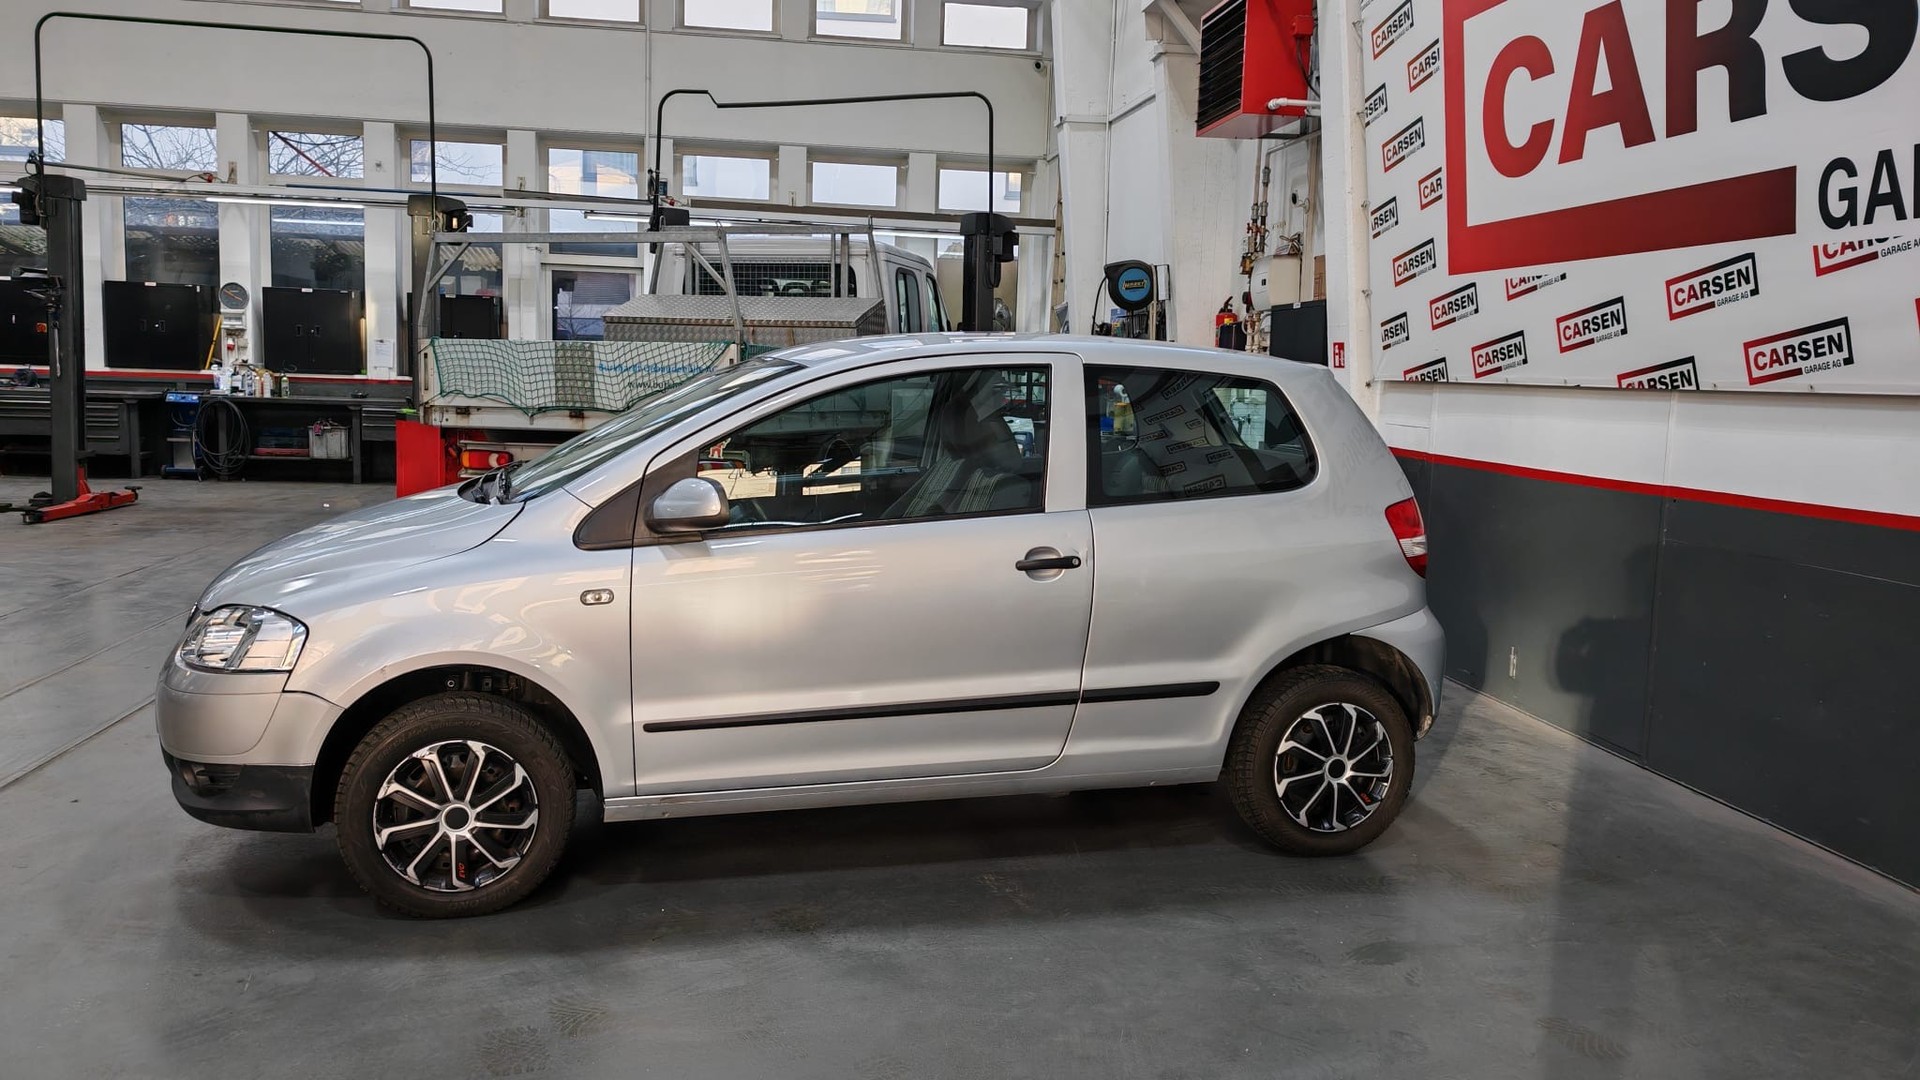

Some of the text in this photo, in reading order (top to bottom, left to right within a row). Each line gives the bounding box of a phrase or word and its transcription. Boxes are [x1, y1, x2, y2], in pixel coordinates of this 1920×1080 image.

[1375, 8, 1410, 48] CARSEN
[1386, 127, 1421, 162] CARSEN
[1818, 144, 1920, 230] GA
[1396, 248, 1433, 277] CARSEN
[1881, 241, 1912, 258] GARAGE
[1674, 266, 1751, 306] CARSEN
[1717, 290, 1749, 307] GARAGE AG
[1434, 292, 1474, 320] CARSEN
[1563, 309, 1621, 341] CARSEN
[1476, 341, 1522, 368] CARSEN
[1754, 333, 1844, 371] CARSEN
[1804, 359, 1842, 374] GARAGE AG
